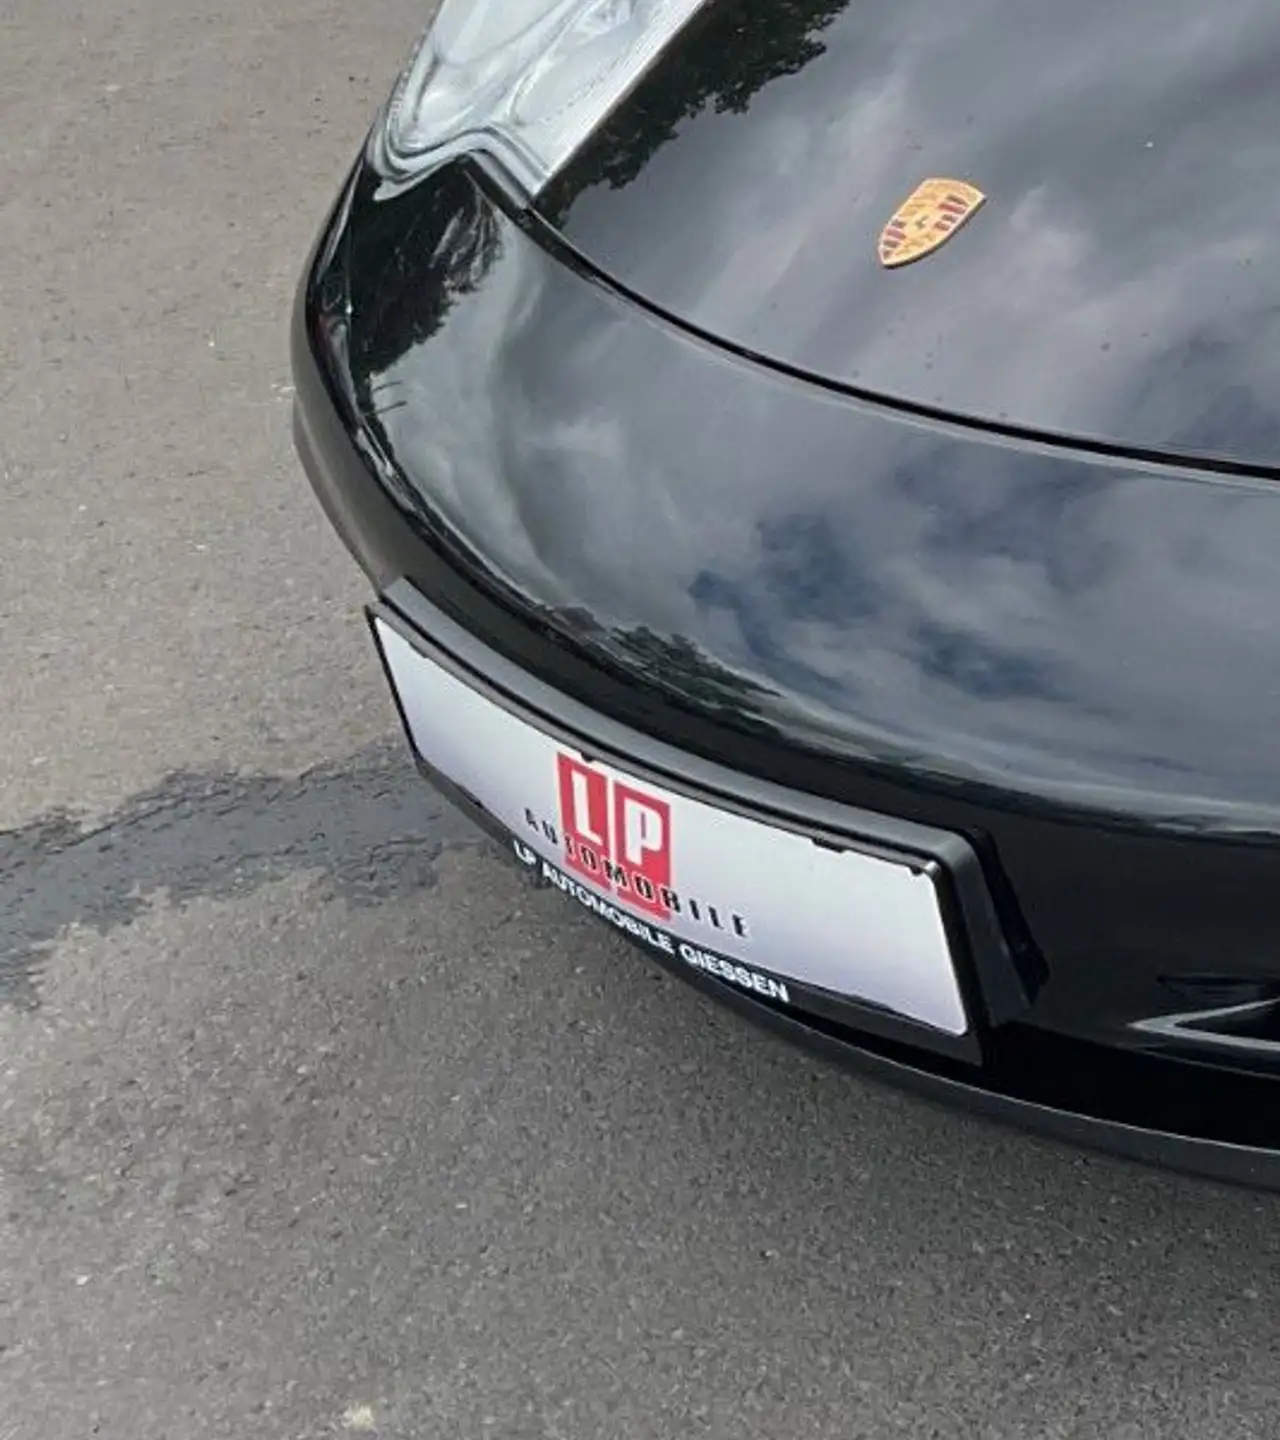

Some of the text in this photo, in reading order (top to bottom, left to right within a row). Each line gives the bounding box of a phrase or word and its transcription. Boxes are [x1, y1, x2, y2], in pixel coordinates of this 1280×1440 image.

[524, 807, 750, 938] AUTOMOBILE
[571, 769, 663, 866] LP
[513, 839, 790, 1004] LP AUTOMOBILE GIESSEN
